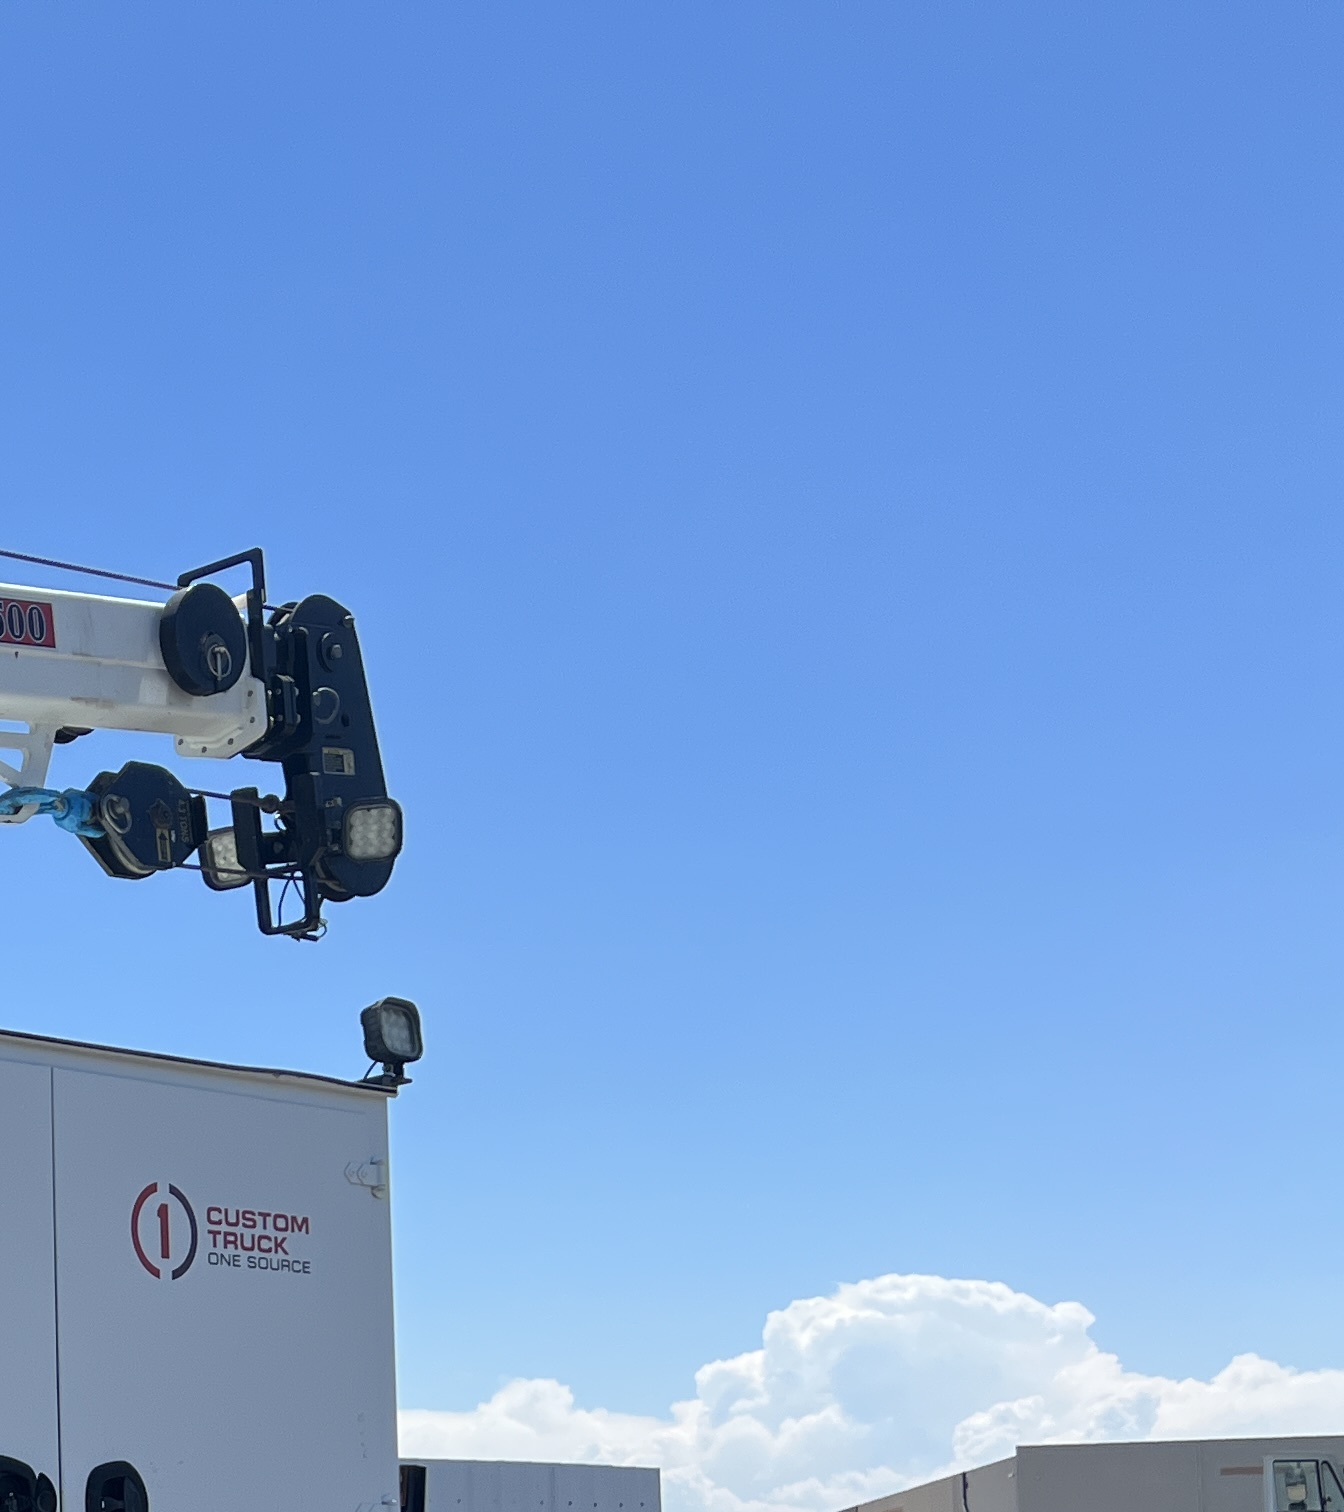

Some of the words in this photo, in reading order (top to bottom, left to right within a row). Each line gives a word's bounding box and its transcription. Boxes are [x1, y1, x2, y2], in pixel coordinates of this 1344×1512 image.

[206, 1206, 310, 1235] CUSTOM
[207, 1229, 290, 1255] TRUCK
[207, 1252, 242, 1268] ONE
[247, 1255, 312, 1275] SOURCE
